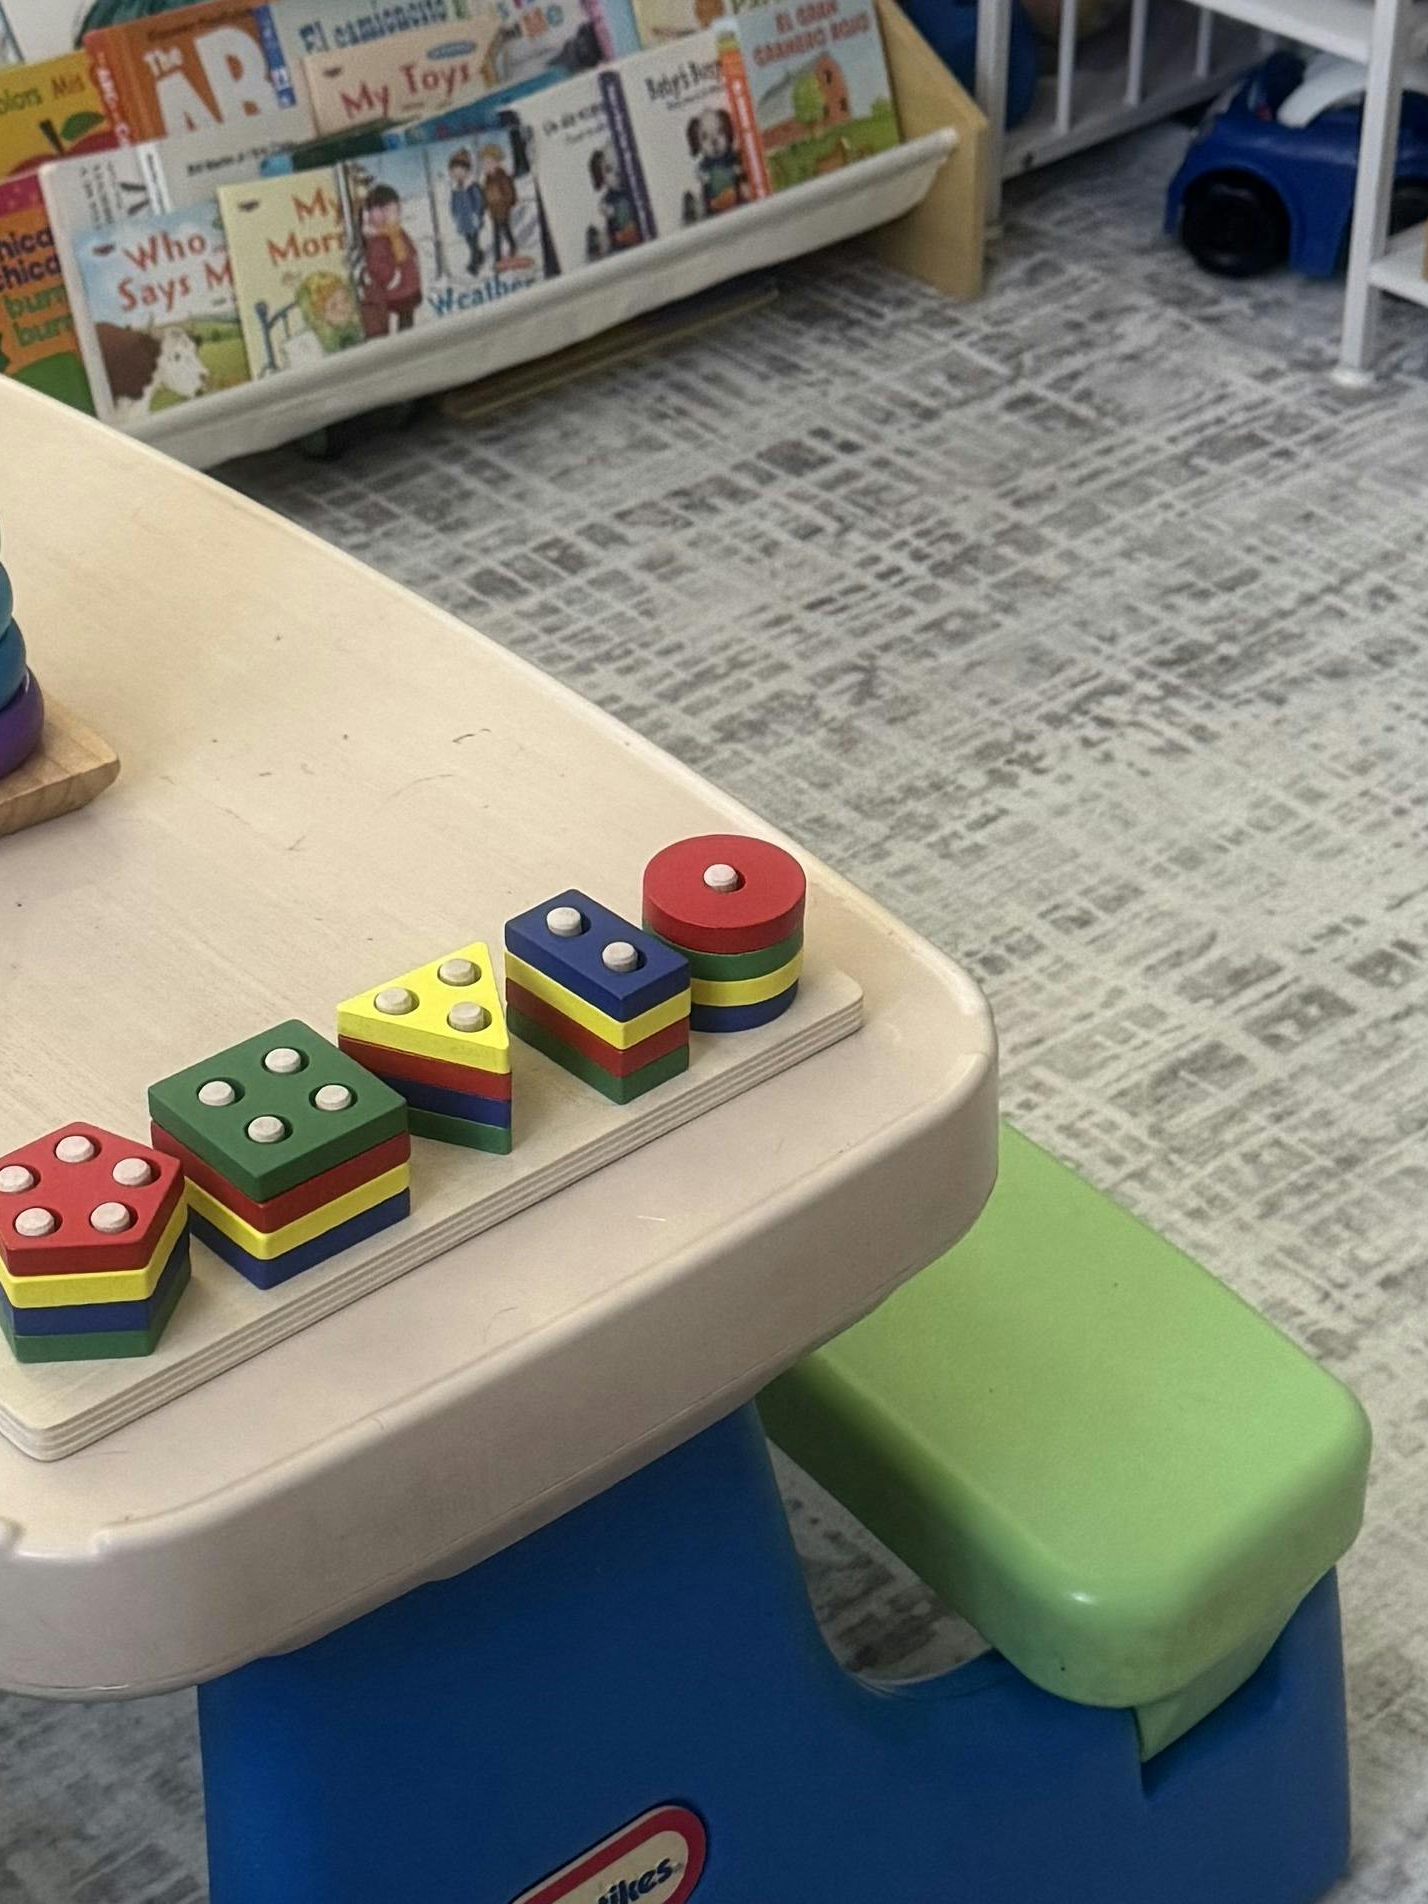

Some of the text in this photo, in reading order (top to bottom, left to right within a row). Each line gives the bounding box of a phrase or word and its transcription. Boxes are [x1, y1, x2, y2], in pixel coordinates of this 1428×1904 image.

[298, 19, 329, 55] El
[143, 47, 183, 77] The
[338, 61, 472, 121] My Toys
[123, 230, 207, 275] Who
[117, 259, 234, 314] Says M
